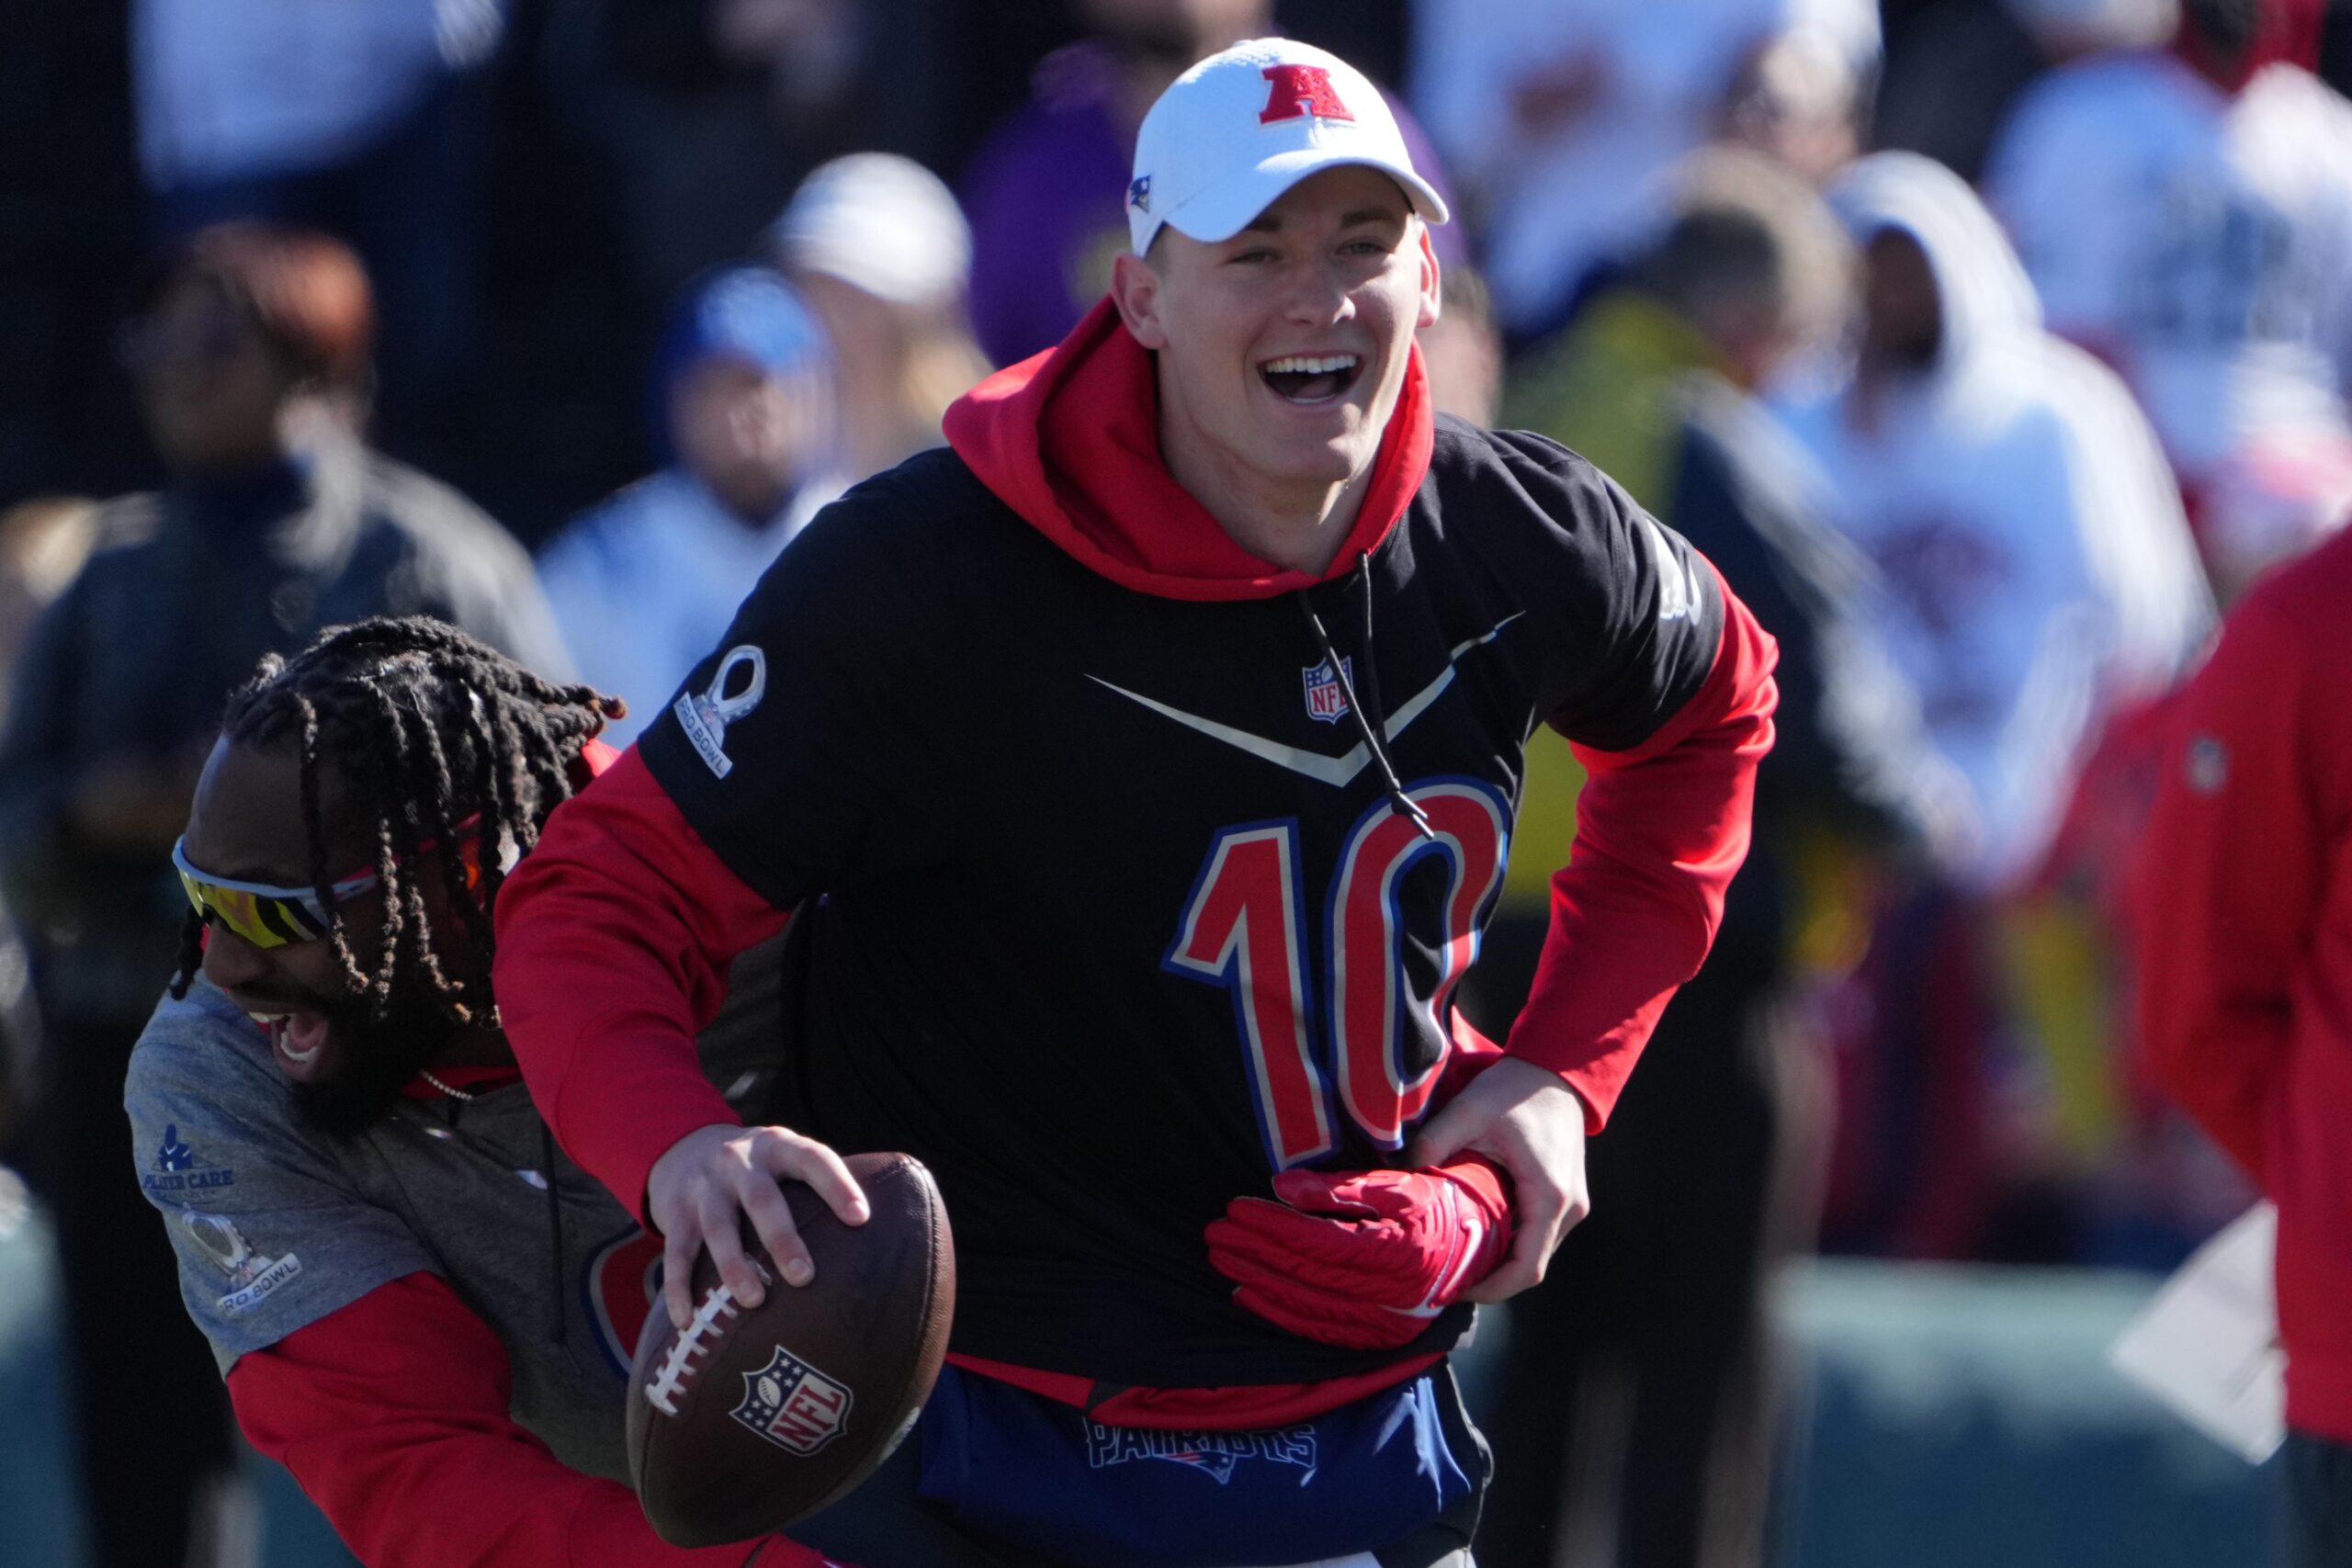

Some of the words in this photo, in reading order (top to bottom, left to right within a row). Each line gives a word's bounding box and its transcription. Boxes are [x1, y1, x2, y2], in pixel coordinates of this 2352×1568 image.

[1259, 63, 1355, 125] A
[678, 698, 695, 729] PRO
[692, 727, 723, 774] BOWL
[1160, 774, 1515, 1174] 10
[187, 1169, 235, 1189] CARE
[219, 1292, 248, 1313] RO
[253, 1262, 299, 1298] BOWL
[772, 1383, 844, 1449] NFL
